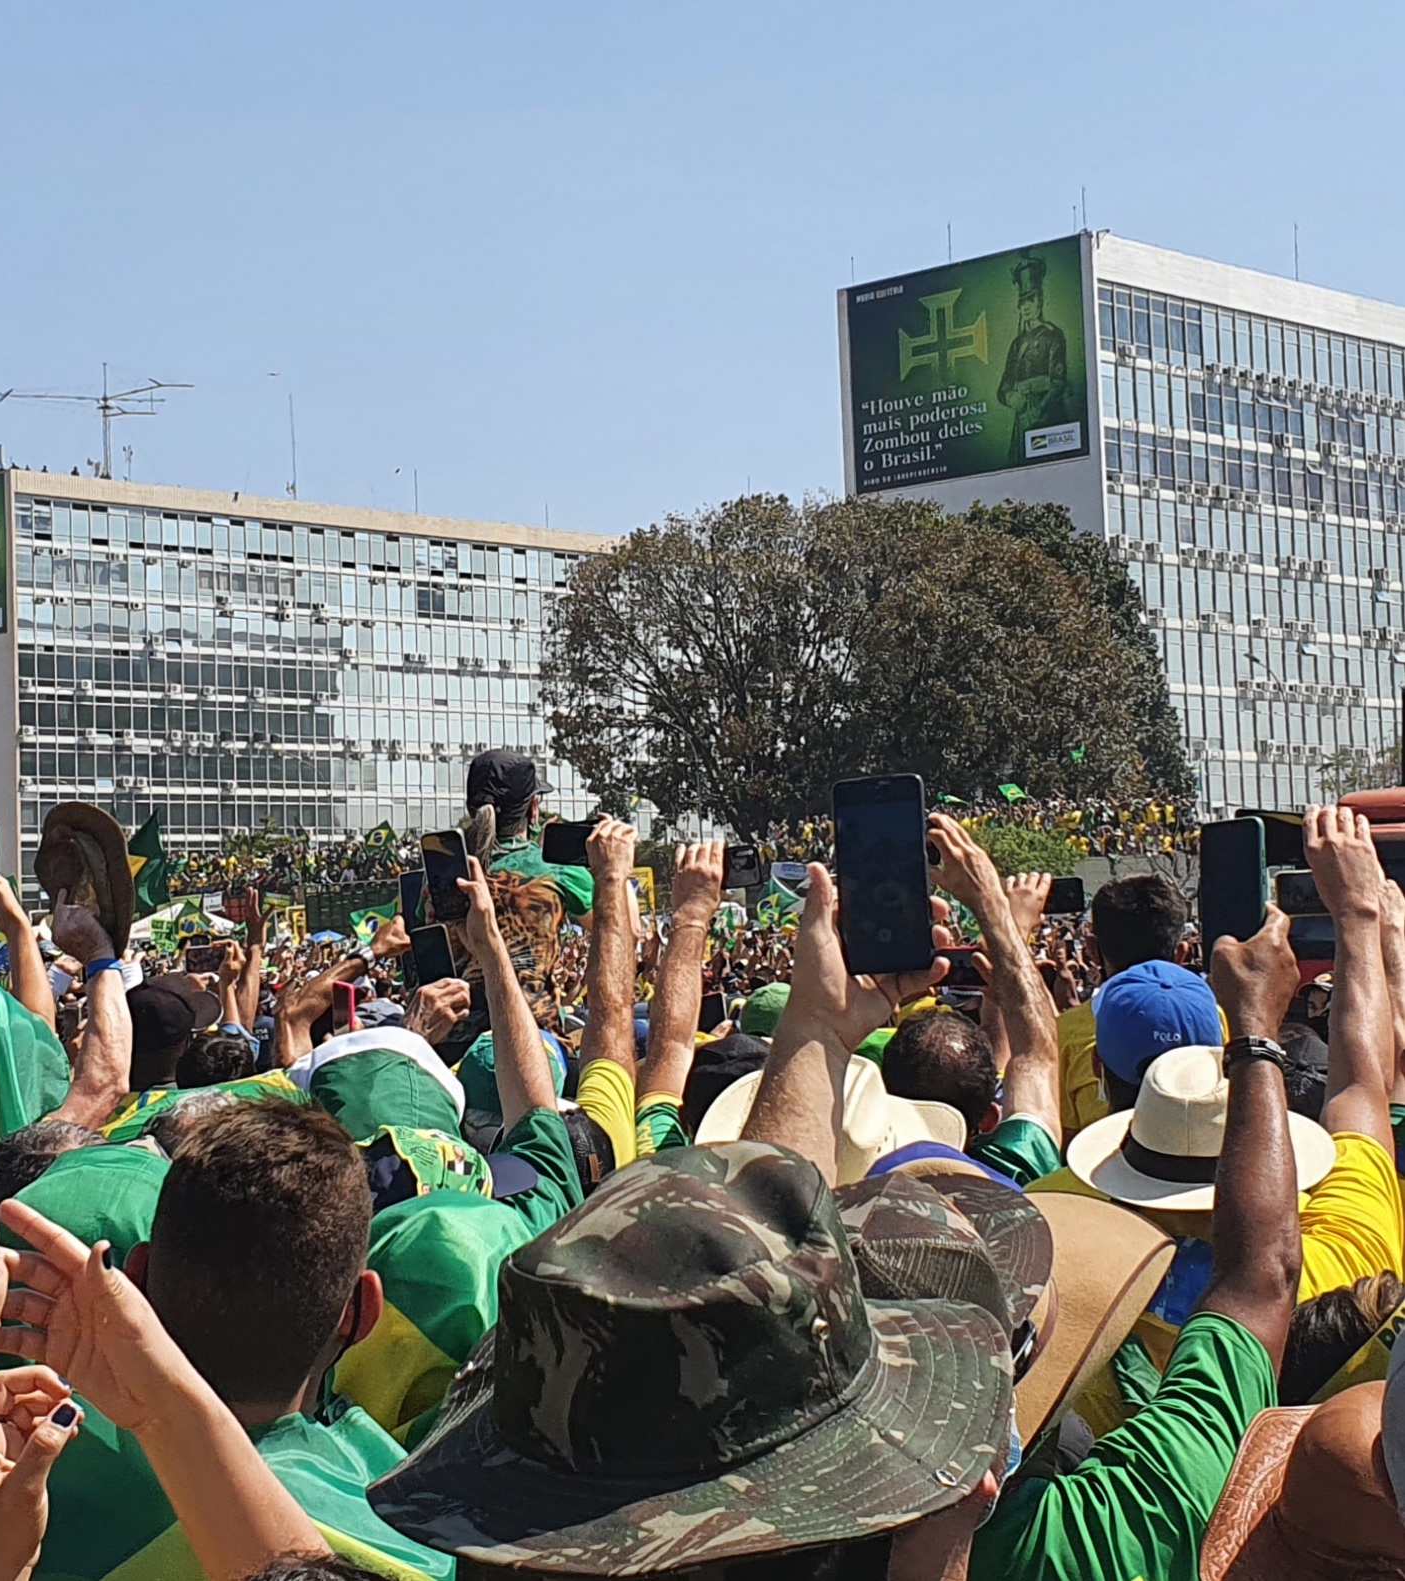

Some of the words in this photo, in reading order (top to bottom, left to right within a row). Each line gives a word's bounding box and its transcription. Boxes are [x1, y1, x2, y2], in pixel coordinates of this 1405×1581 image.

[861, 395, 924, 416] “Houve
[932, 384, 969, 404] mão
[862, 416, 902, 435] mais
[909, 402, 988, 431] poderosa
[863, 430, 931, 454] Zombou
[938, 418, 984, 441] deles
[863, 460, 874, 472] o
[1153, 1030, 1182, 1042] POLO
